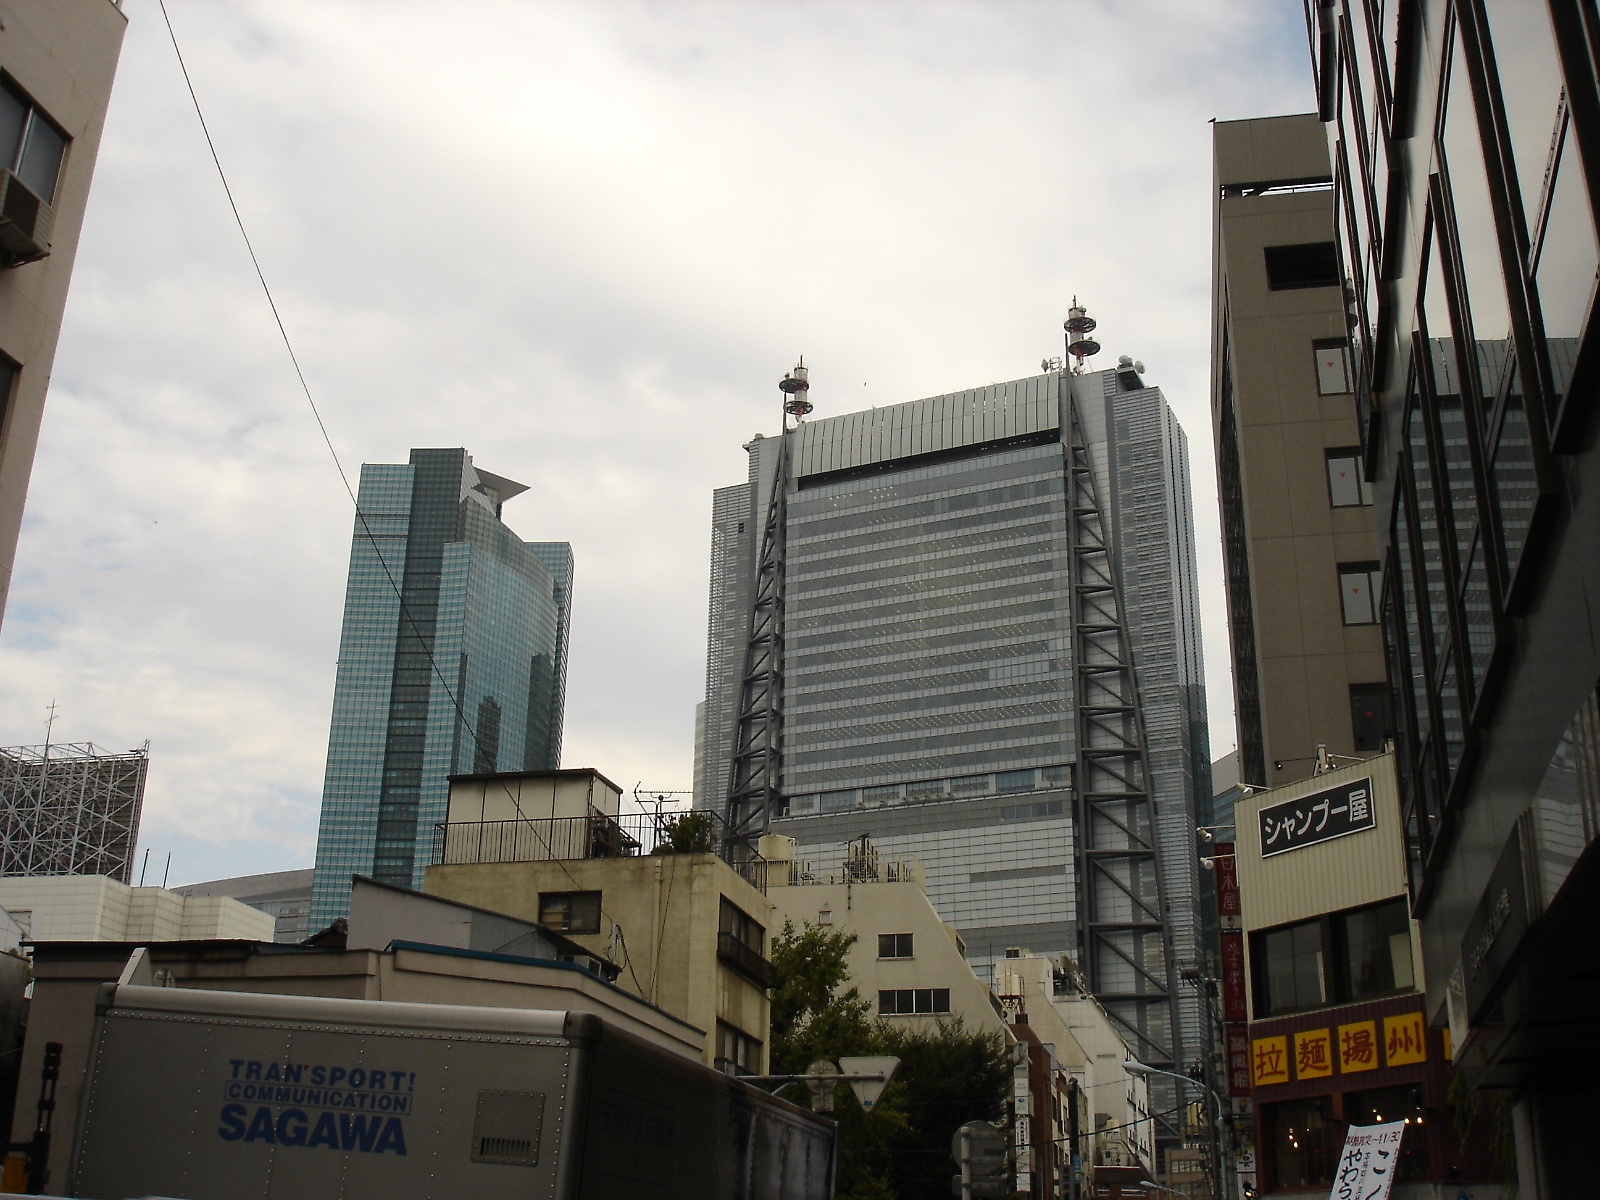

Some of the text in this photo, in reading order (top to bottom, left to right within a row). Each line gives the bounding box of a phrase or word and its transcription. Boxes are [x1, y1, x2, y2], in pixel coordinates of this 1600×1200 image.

[1265, 789, 1368, 845] シャンプー屋
[228, 1083, 408, 1112] COMMUNICATION
[218, 1103, 407, 1155] SAGAWA
[1339, 1148, 1363, 1200] やわら
